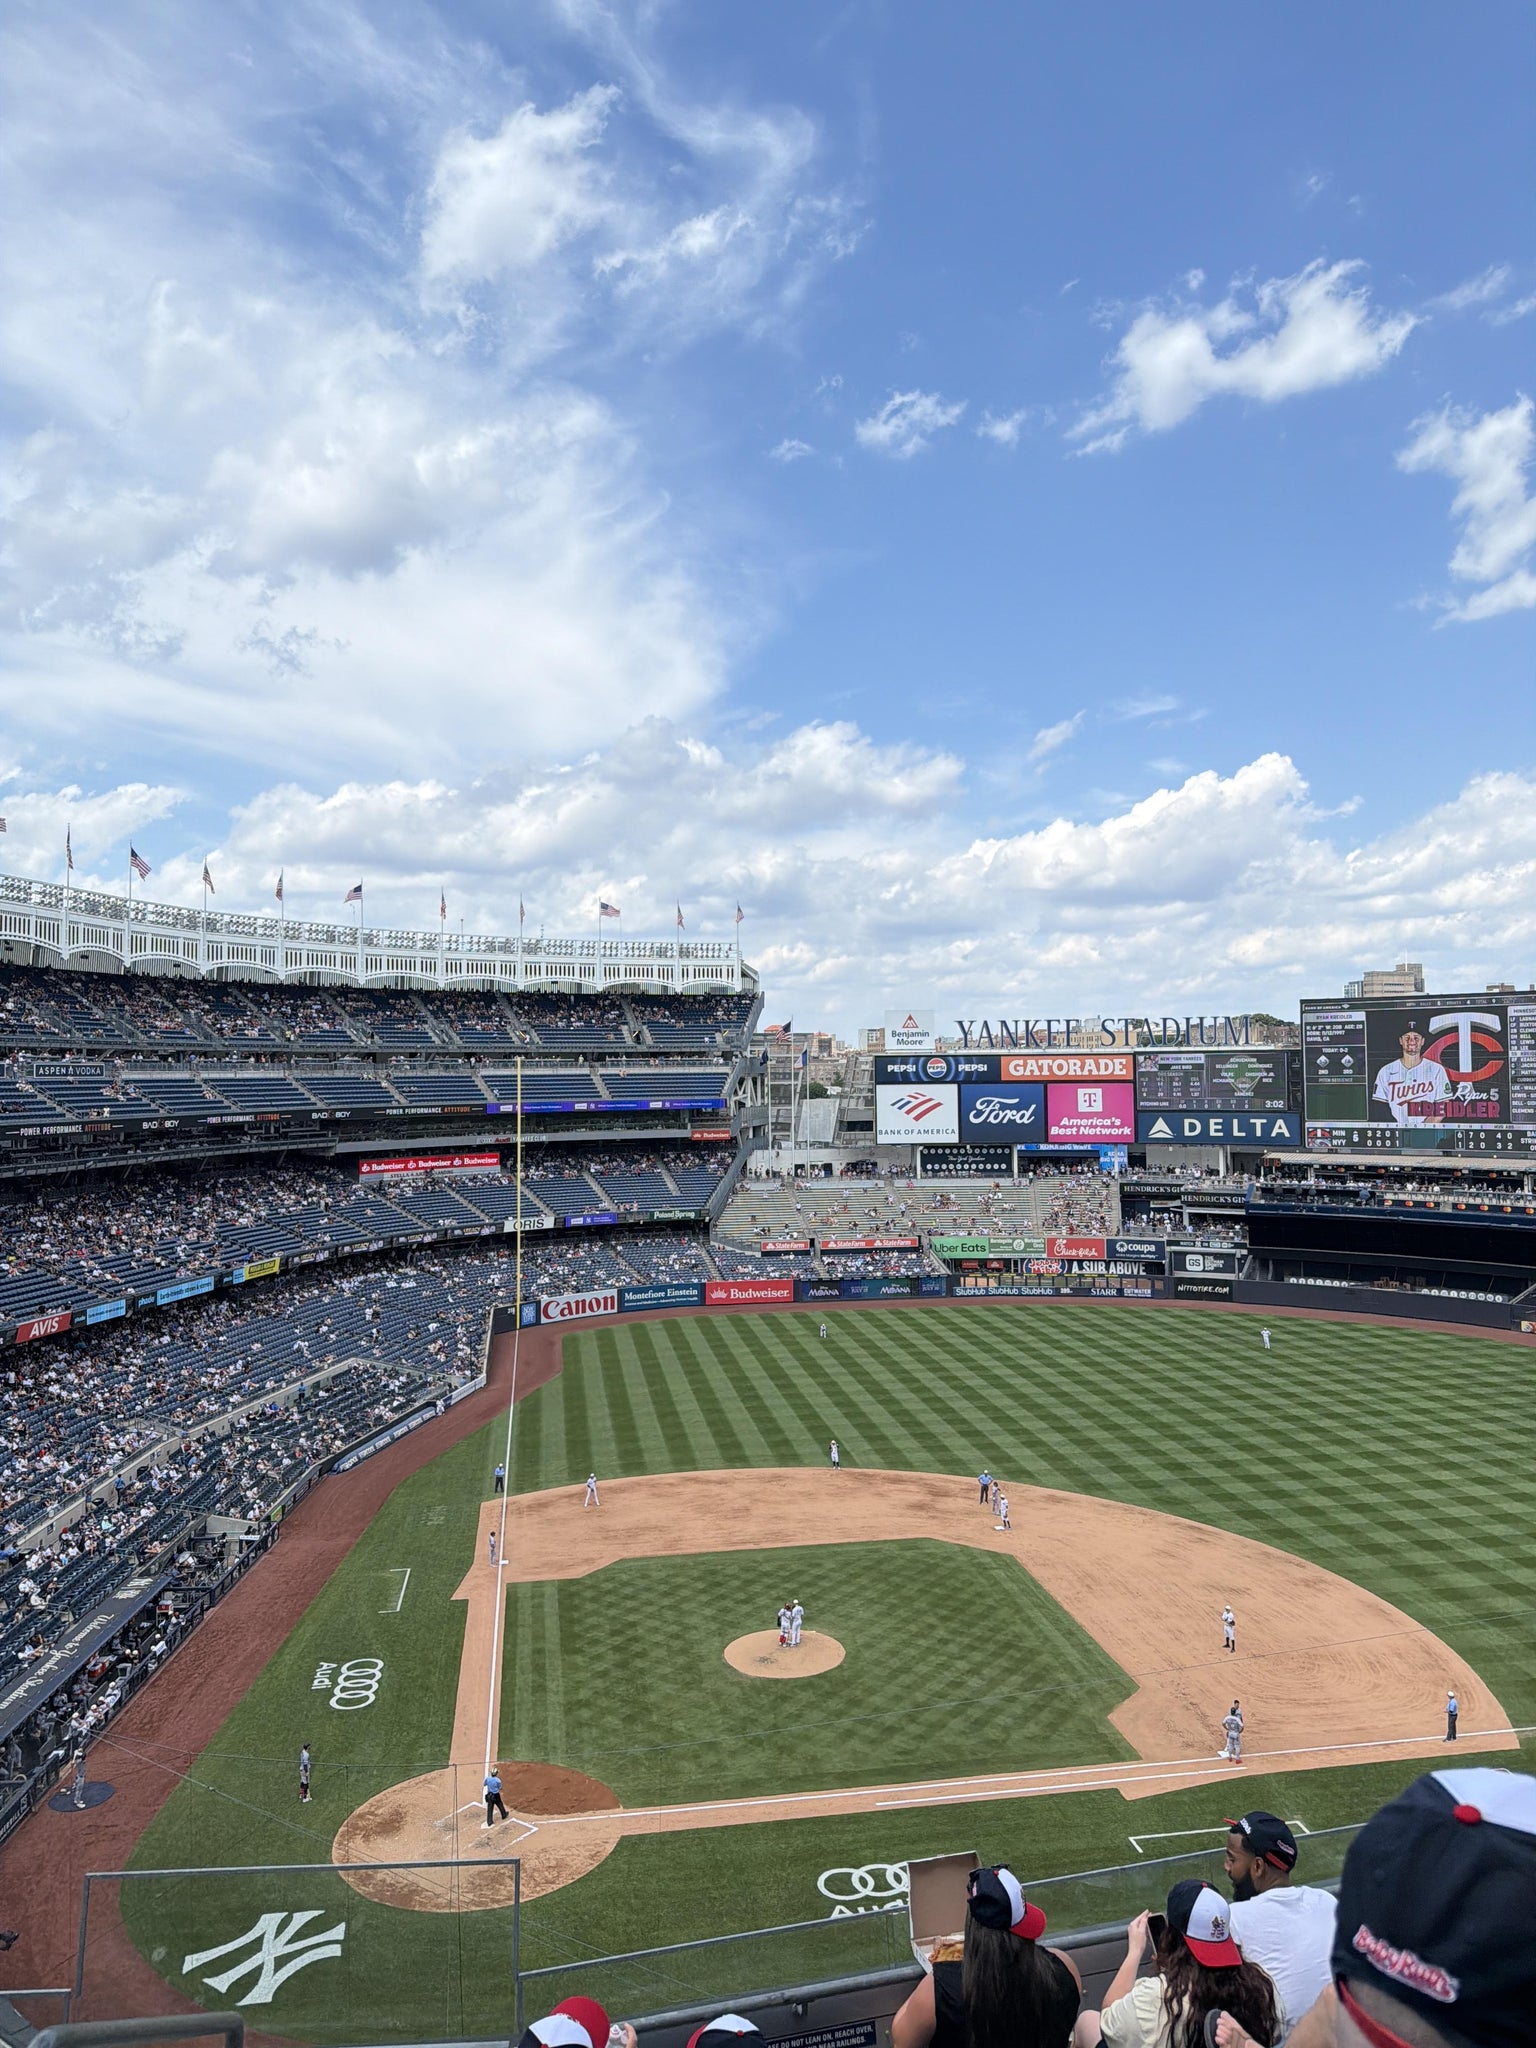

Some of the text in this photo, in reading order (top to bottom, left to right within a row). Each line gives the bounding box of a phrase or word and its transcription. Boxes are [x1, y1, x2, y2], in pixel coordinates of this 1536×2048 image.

[892, 1030, 929, 1039] Benjamin
[954, 1017, 1251, 1048] YANKEE STADIUM
[76, 1067, 101, 1075] VODKA
[887, 1064, 916, 1072] PEPSI
[1008, 1059, 1127, 1076] GATORADE
[1388, 1081, 1434, 1102] Twins
[1453, 1084, 1498, 1106] Ryan 5
[970, 1097, 1036, 1124] Ford
[1408, 1102, 1500, 1118] KREIDLER
[1060, 1117, 1121, 1127] America's
[1050, 1126, 1131, 1136] Best Network
[1183, 1119, 1291, 1138] DELTA
[1181, 1195, 1231, 1203] HENDRICK'S
[513, 1219, 545, 1230] ORIS
[934, 1244, 959, 1253] Uber
[961, 1243, 986, 1253] Eats
[1128, 1243, 1155, 1253] coupa
[1072, 1261, 1147, 1275] A SUB ABOVE
[624, 1288, 698, 1300] Montefiore Einstein
[730, 1288, 789, 1299] Budweiser
[988, 1287, 1019, 1295] StubHub
[1178, 1284, 1229, 1294] NITTOTIRE.COM
[542, 1295, 616, 1320] Canon
[29, 1318, 59, 1338] AVIS
[311, 1662, 338, 1690] Audi
[791, 2039, 803, 2047] NOT
[805, 2035, 821, 2045] LEAN
[835, 2028, 855, 2039] REACH
